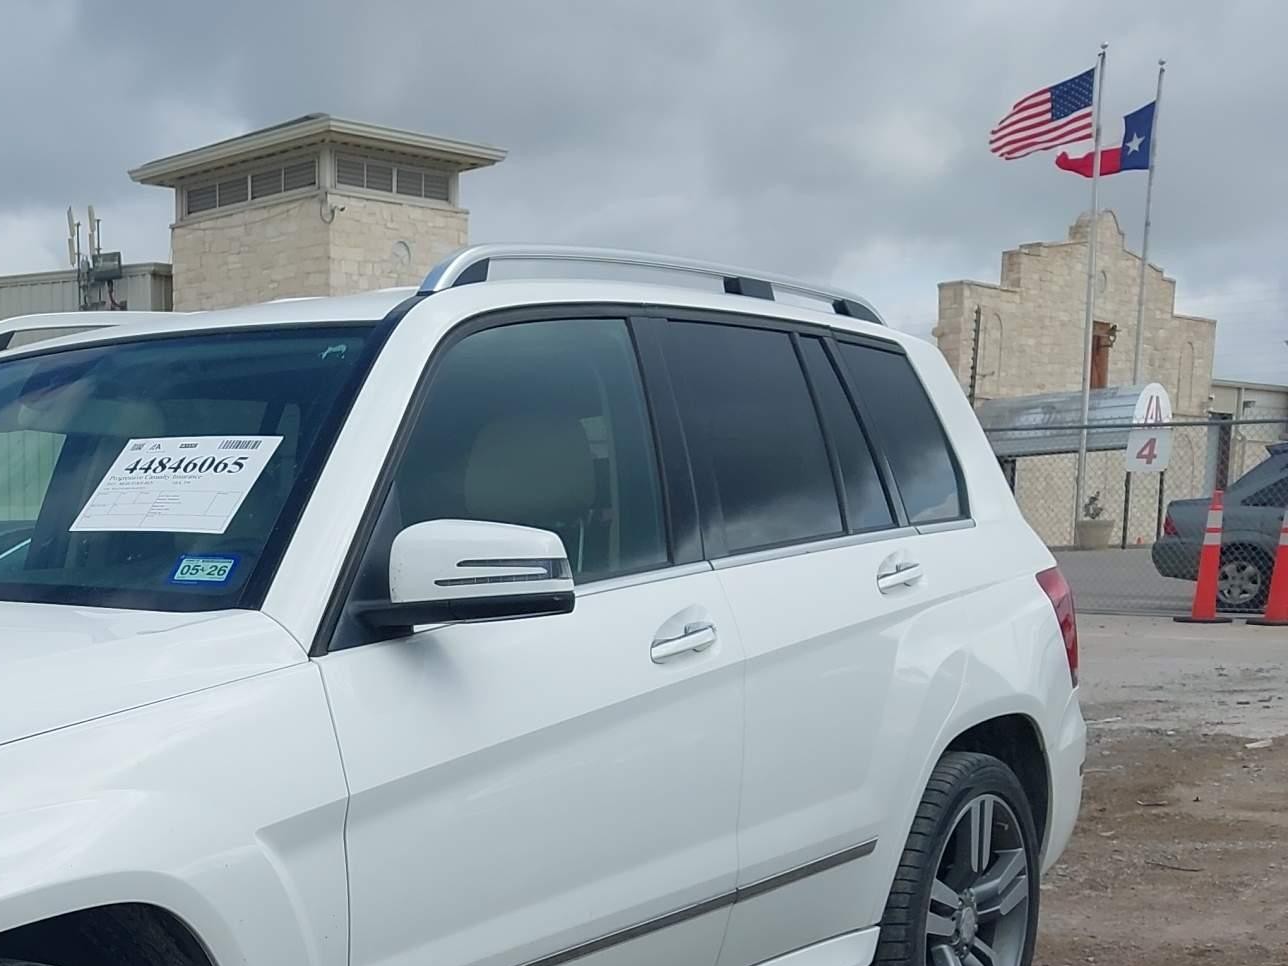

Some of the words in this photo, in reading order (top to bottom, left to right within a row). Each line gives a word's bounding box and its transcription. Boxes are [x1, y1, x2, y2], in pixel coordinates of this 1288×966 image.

[1136, 437, 1157, 465] 4
[124, 455, 249, 474] 44846065
[180, 564, 201, 576] 05
[206, 565, 228, 577] 26
